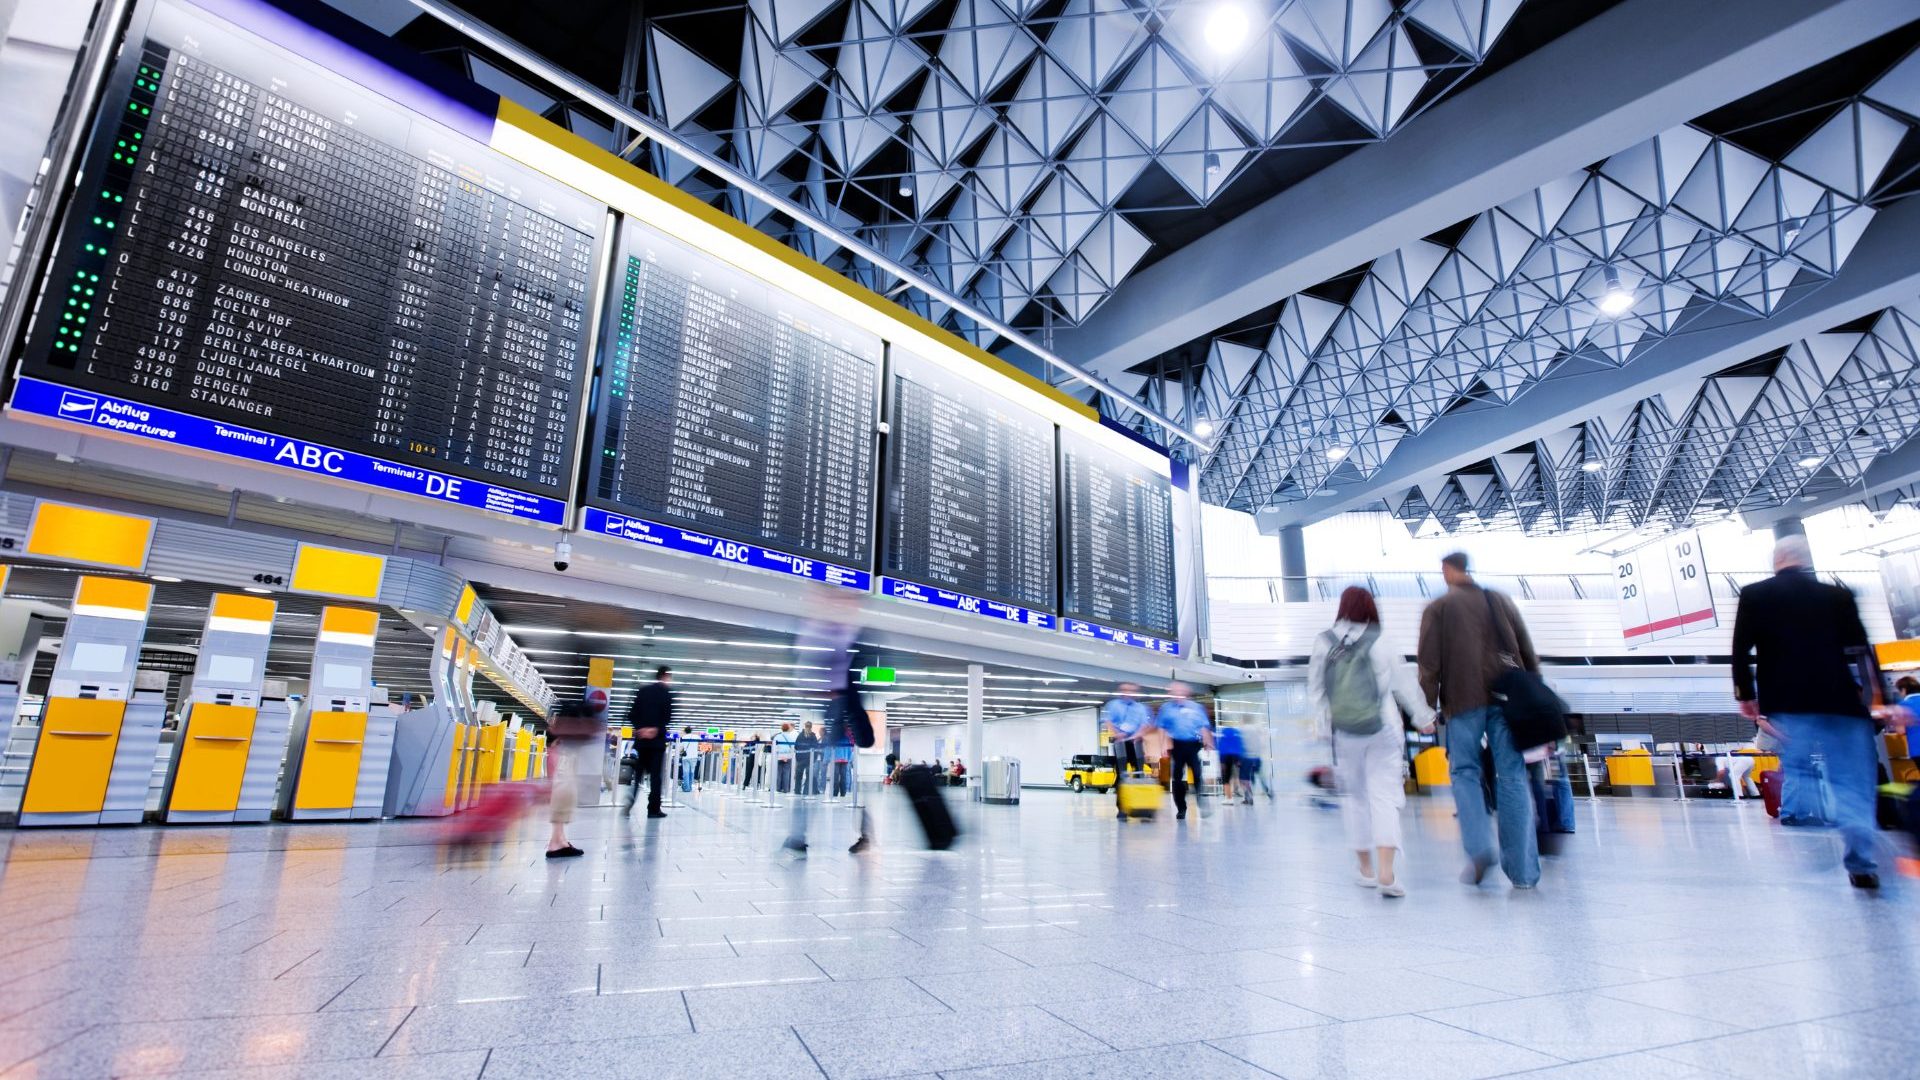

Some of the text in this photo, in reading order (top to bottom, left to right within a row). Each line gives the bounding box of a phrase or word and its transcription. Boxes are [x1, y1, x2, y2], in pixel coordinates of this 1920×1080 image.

[175, 68, 181, 76] L
[264, 107, 329, 140] HELSINKI
[178, 56, 187, 65] D
[267, 96, 331, 129] VARADERO
[161, 115, 167, 124] L
[168, 91, 174, 100] L
[258, 129, 300, 152] MIAMI
[171, 80, 178, 88] L
[261, 118, 326, 151] PORTLAND
[146, 164, 156, 173] A
[240, 198, 308, 230] MONTREAL
[150, 152, 157, 160] L
[243, 186, 302, 215] CALGARY
[132, 215, 288, 274] L 440 HOUSTON
[135, 202, 291, 262] L 442 DETROIT
[139, 189, 326, 262] L 456 LOS ANGELES
[128, 228, 350, 307] L 4726 LONDON-HEATHROW
[116, 268, 123, 276] L
[157, 279, 194, 298] 6808
[214, 296, 260, 318] KOELN
[267, 312, 294, 328] HBF
[170, 269, 198, 285] 417
[217, 284, 271, 308] ZAGREB
[112, 281, 119, 290] L
[163, 295, 191, 311] 686
[210, 309, 239, 325] TEL
[247, 320, 283, 338] AVIV
[100, 322, 108, 331] J
[152, 334, 180, 350] 117
[200, 348, 282, 378] LJUBLJANA
[104, 308, 112, 317] L
[156, 321, 184, 337] 176
[204, 335, 310, 372] BERLIN-TEGEL
[108, 294, 115, 303] L
[159, 308, 188, 324] 590
[207, 322, 254, 343] ADDIS
[261, 338, 376, 378] ABEBA-KHARTOUM
[92, 350, 100, 359] L
[134, 359, 173, 377] 3126
[193, 374, 250, 397] BERGEN
[96, 336, 104, 345] L
[138, 346, 177, 364] 4980
[197, 361, 253, 384] DUBLIN
[88, 364, 95, 373] L
[130, 373, 170, 391] 3160
[190, 388, 274, 416] STAVANGER
[97, 414, 176, 438] Departures
[101, 400, 150, 420] Abflug
[214, 425, 344, 473] Terminal 1 ABC
[671, 457, 704, 472] VILNIUS
[372, 462, 462, 500] Terminal 2 DE
[669, 476, 707, 493] HELSINKI
[670, 467, 704, 482] TORONTO
[625, 520, 650, 532] Abflug
[666, 506, 695, 519] DUBLIN
[0, 538, 14, 549] 5
[624, 530, 663, 544] Departures
[680, 532, 708, 545] Terminal
[712, 540, 748, 562] ABC
[763, 550, 786, 562] Terminal
[792, 558, 812, 576] DE
[1618, 542, 1692, 578] 20 10
[254, 573, 282, 586] 464
[1622, 564, 1696, 600] 20 10
[958, 596, 980, 612] ABC
[1006, 607, 1020, 621] DE
[1112, 630, 1128, 644] ABC
[1144, 638, 1154, 648] DE
